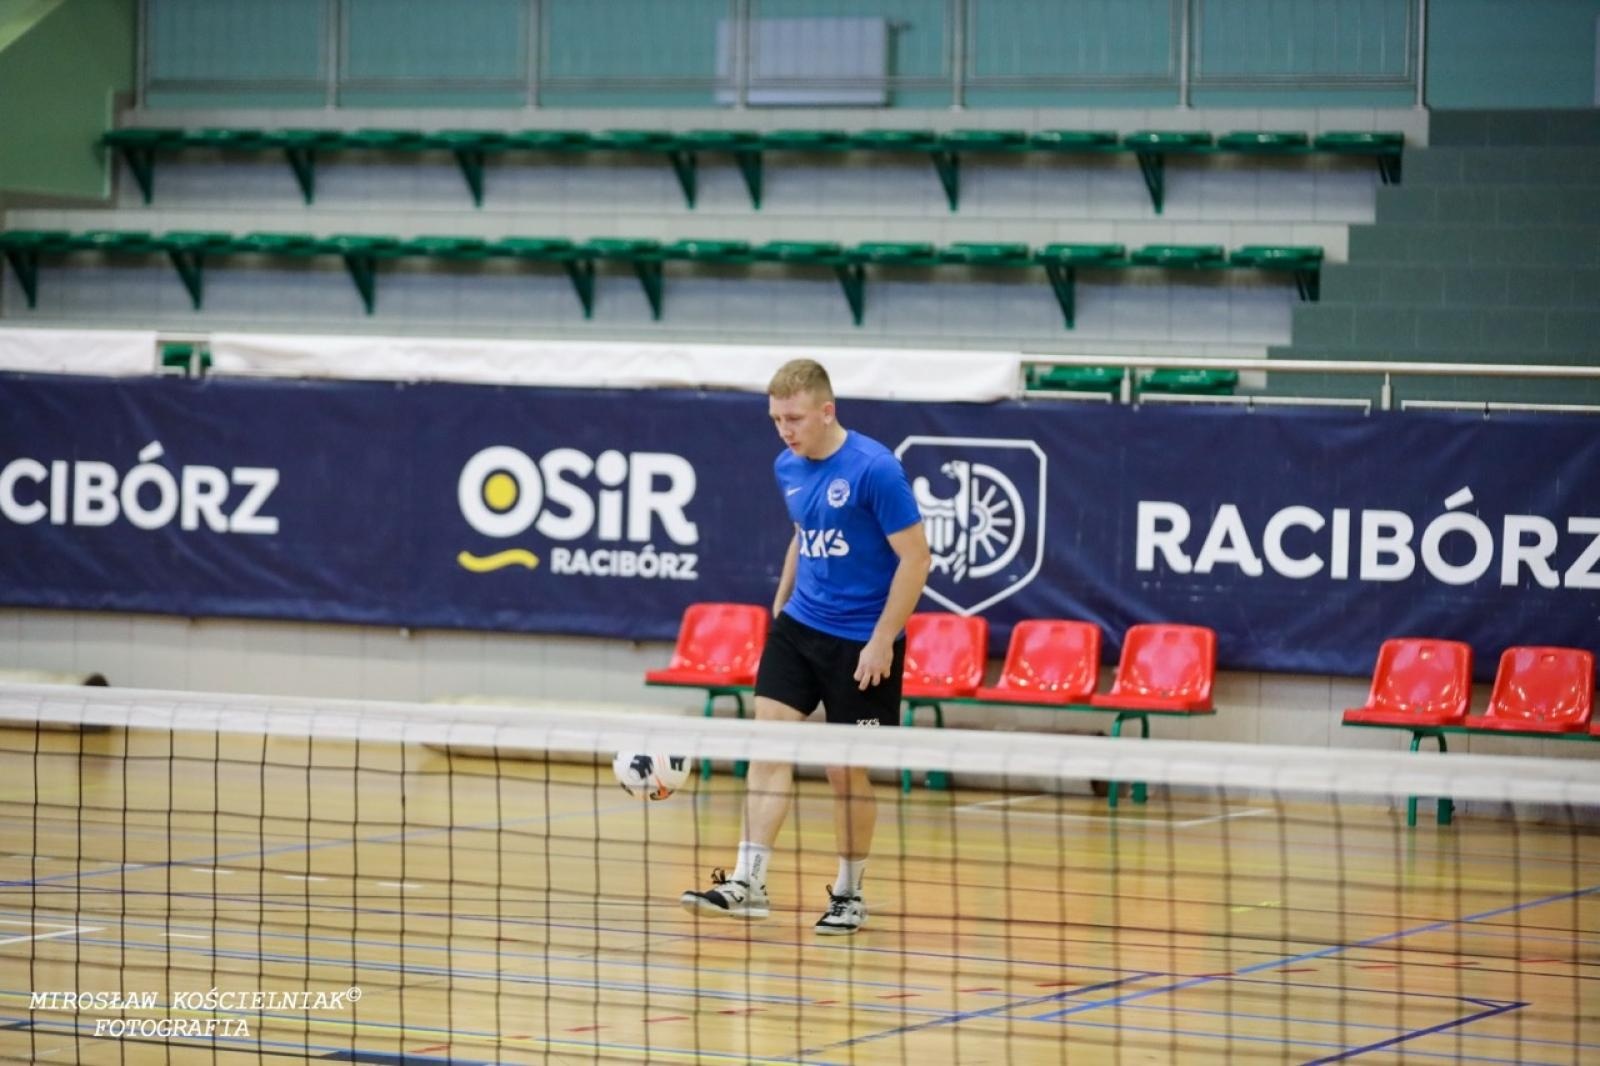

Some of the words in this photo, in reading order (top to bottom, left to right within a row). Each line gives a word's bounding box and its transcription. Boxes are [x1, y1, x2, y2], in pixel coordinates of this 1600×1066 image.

[0, 440, 279, 535] CIBÓRZ
[550, 544, 698, 581] RACIBÓRZ
[1136, 487, 1600, 590] RACIBÓRZ
